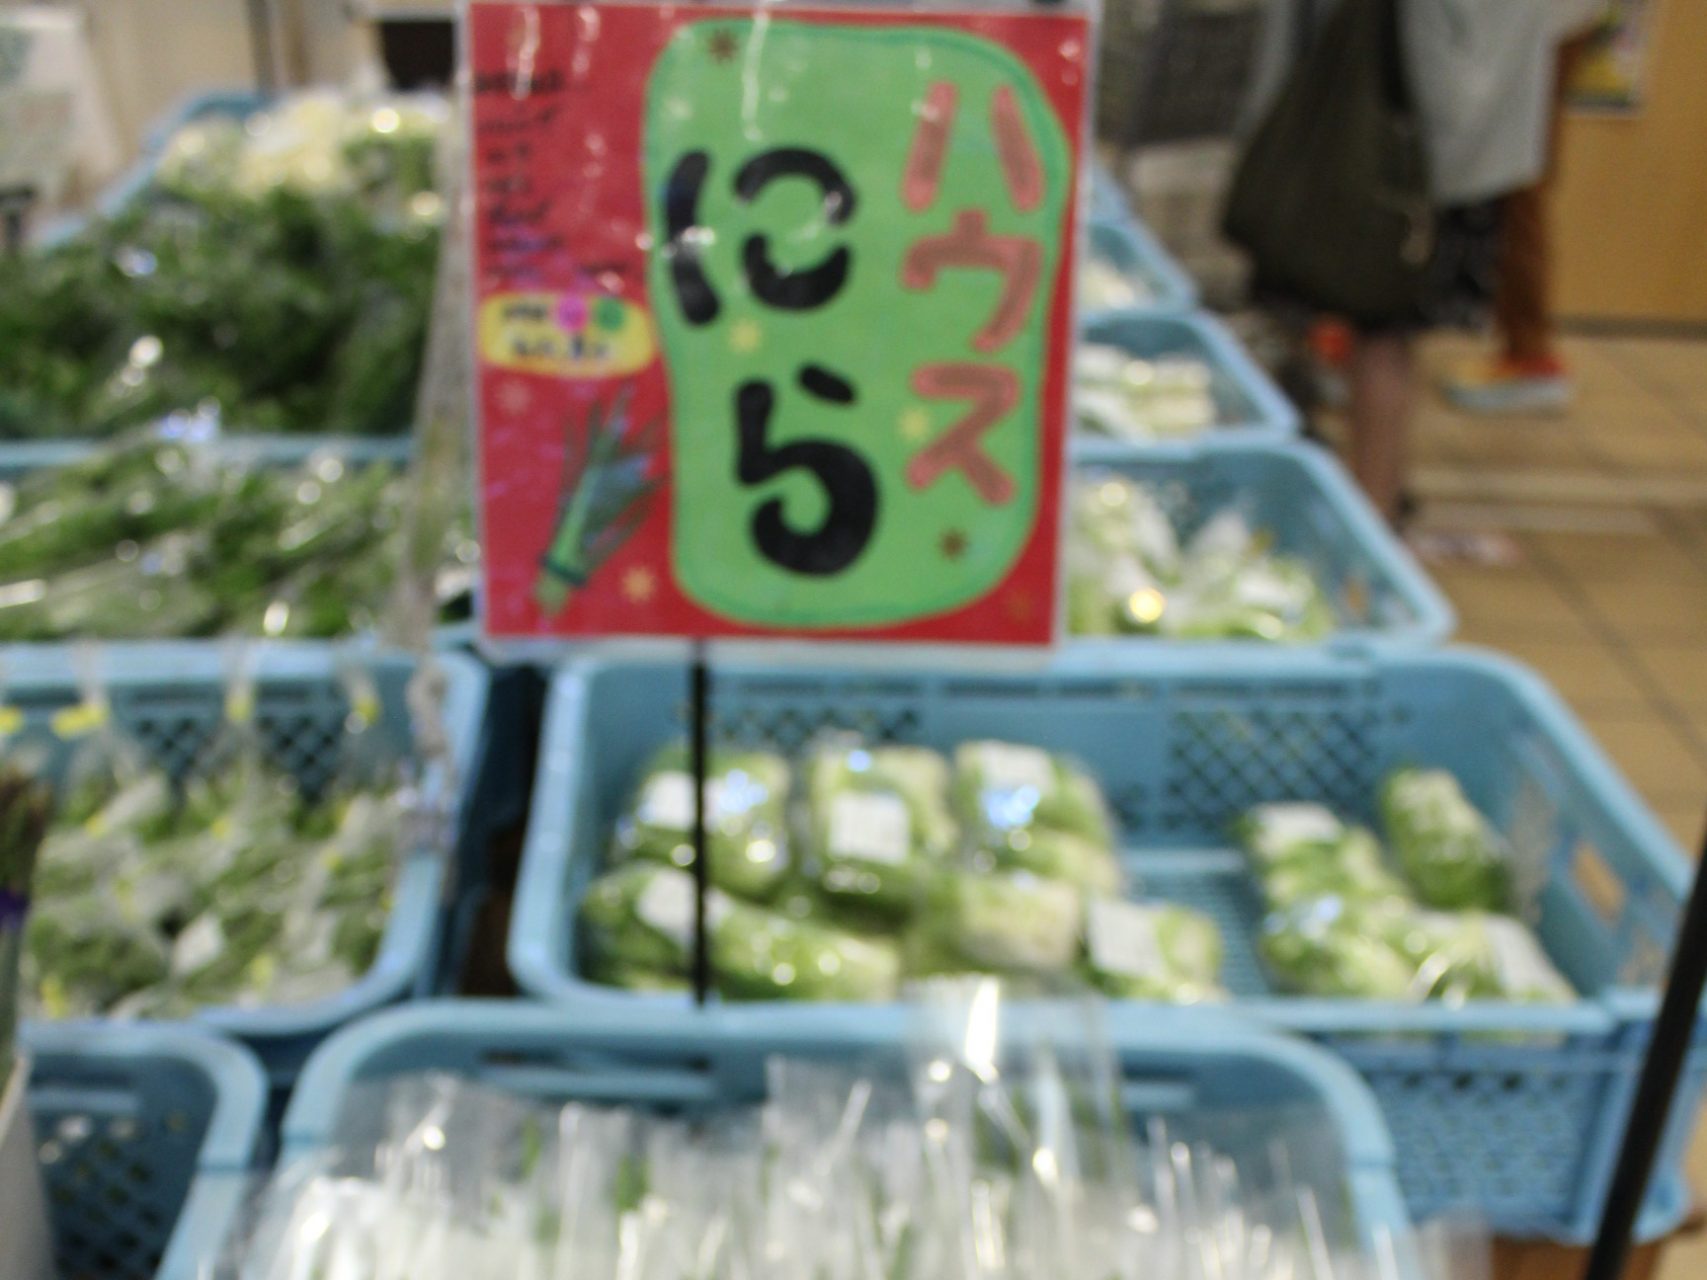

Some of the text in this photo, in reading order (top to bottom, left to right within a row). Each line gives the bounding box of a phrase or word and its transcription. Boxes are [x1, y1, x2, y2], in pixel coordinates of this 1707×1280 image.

[664, 147, 881, 578] にら
[902, 81, 1046, 507] ハウス
